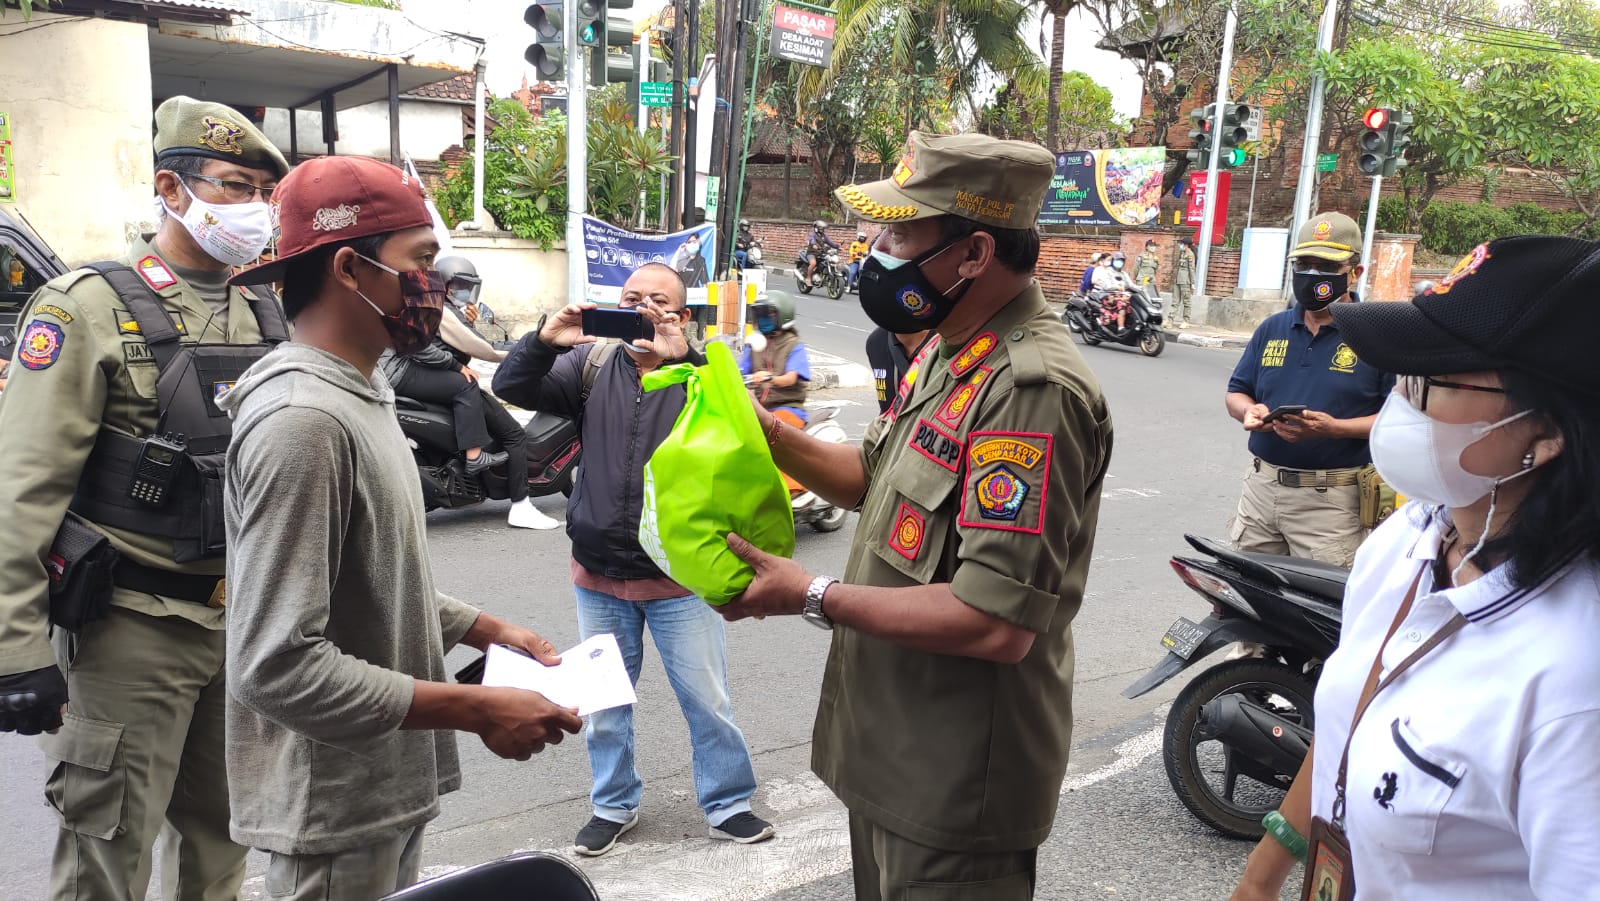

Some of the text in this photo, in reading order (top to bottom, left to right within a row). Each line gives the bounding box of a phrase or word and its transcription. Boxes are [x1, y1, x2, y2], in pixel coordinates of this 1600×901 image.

[783, 11, 826, 32] PASAR
[782, 31, 803, 44] DESA
[803, 37, 824, 48] ADAT
[779, 40, 824, 58] KESIMAN
[956, 190, 985, 206] KASAT
[987, 199, 1001, 210] POL
[914, 423, 959, 463] POL PP
[982, 449, 1027, 464] DENPASAR
[1017, 445, 1037, 460] KOTA
